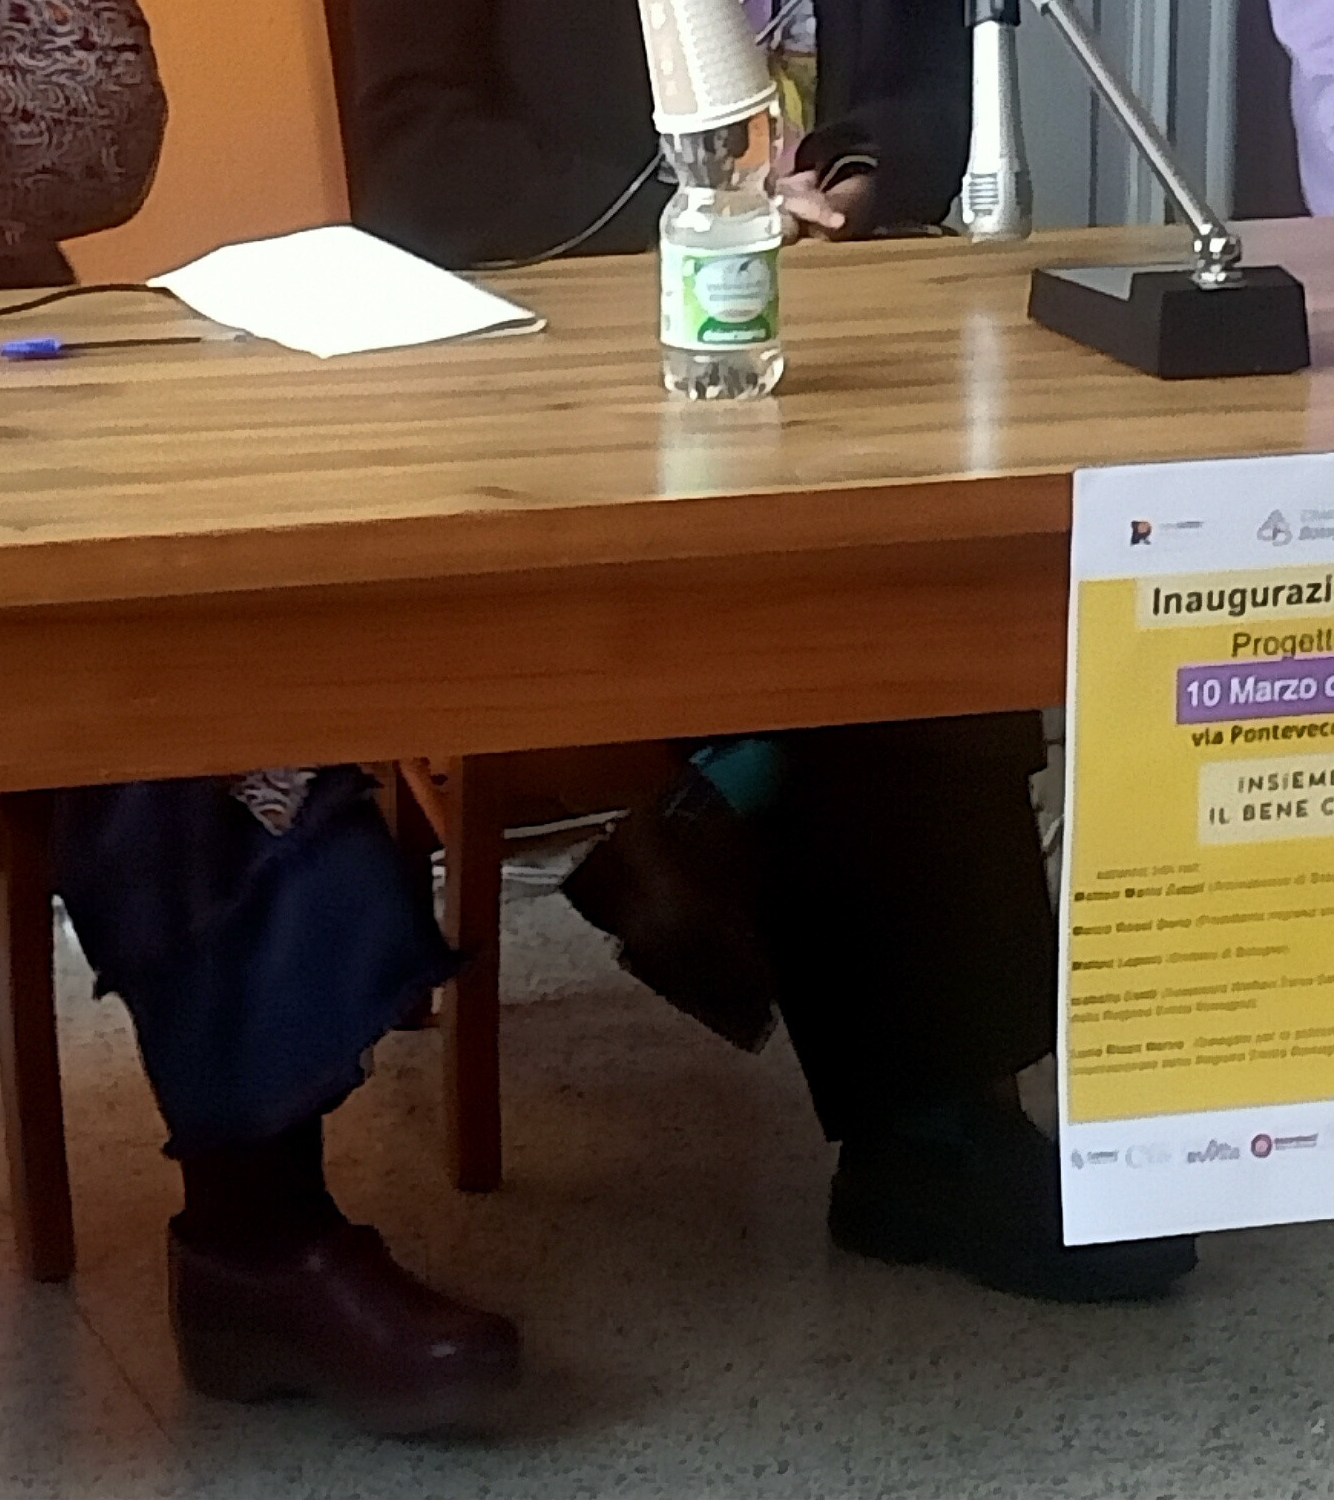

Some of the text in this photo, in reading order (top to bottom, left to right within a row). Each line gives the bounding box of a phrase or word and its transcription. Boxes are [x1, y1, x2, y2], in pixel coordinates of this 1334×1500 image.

[1185, 677, 1222, 708] 10
[1229, 668, 1317, 705] Marzo
[1191, 728, 1225, 748] via
[1208, 806, 1231, 826] IL
[1242, 801, 1311, 822] BENE
